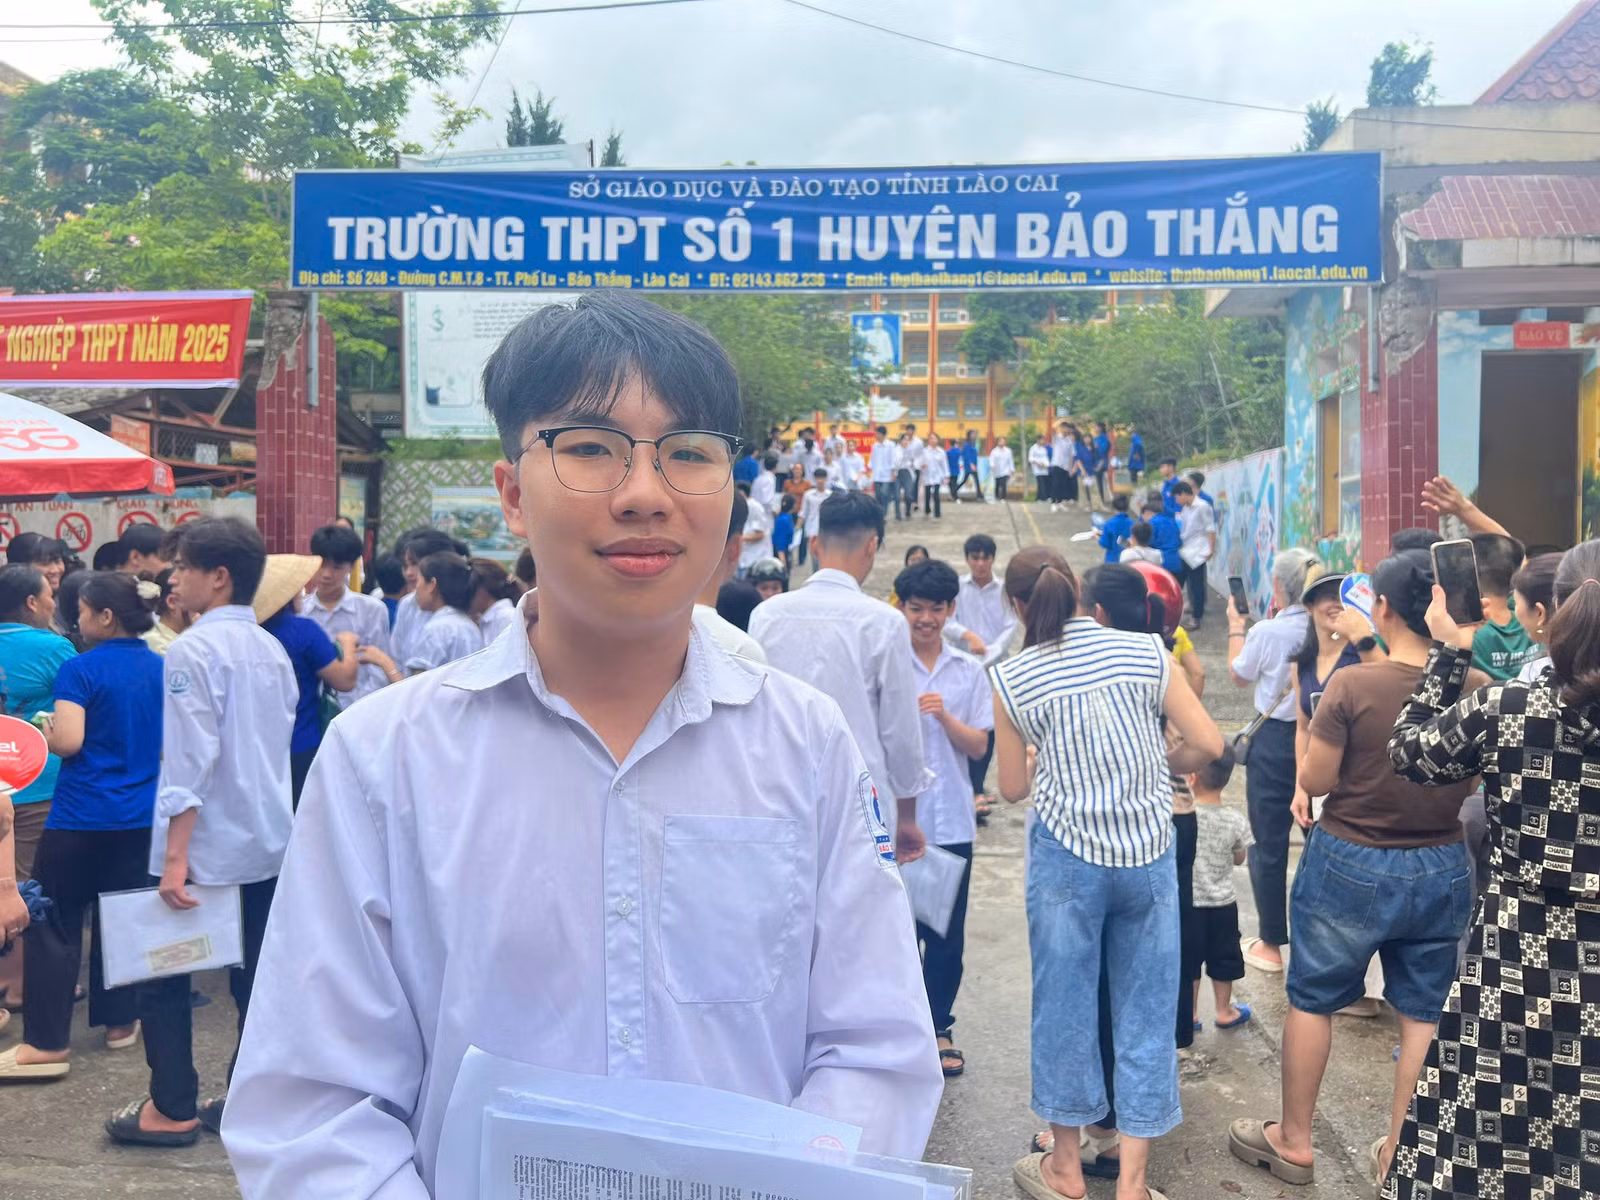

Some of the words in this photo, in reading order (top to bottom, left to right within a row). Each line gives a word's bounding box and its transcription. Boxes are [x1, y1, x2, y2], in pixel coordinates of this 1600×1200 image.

[569, 174, 600, 198] SỞ
[606, 177, 667, 198] GIÁO
[673, 181, 723, 202] DỤC
[729, 177, 763, 197] VÀ
[770, 176, 823, 197] ĐÀO
[828, 178, 880, 200] TẠO
[887, 172, 950, 195] TỈNH
[956, 172, 1008, 194] LÀO
[1015, 174, 1059, 193] CAI
[327, 205, 525, 261] TRƯỜNG
[541, 216, 666, 261] THPT
[682, 201, 756, 263] SỐ
[771, 217, 794, 262] 1
[818, 205, 997, 270] HUYỆN
[1016, 192, 1128, 259] BẢO
[1147, 191, 1339, 257] THẮNG
[846, 271, 888, 287] Email:
[1109, 267, 1167, 283] website:
[6, 316, 77, 371] NGHIỆP
[81, 323, 128, 363] THPT
[131, 315, 178, 363] NĂM
[181, 323, 231, 363] 2025
